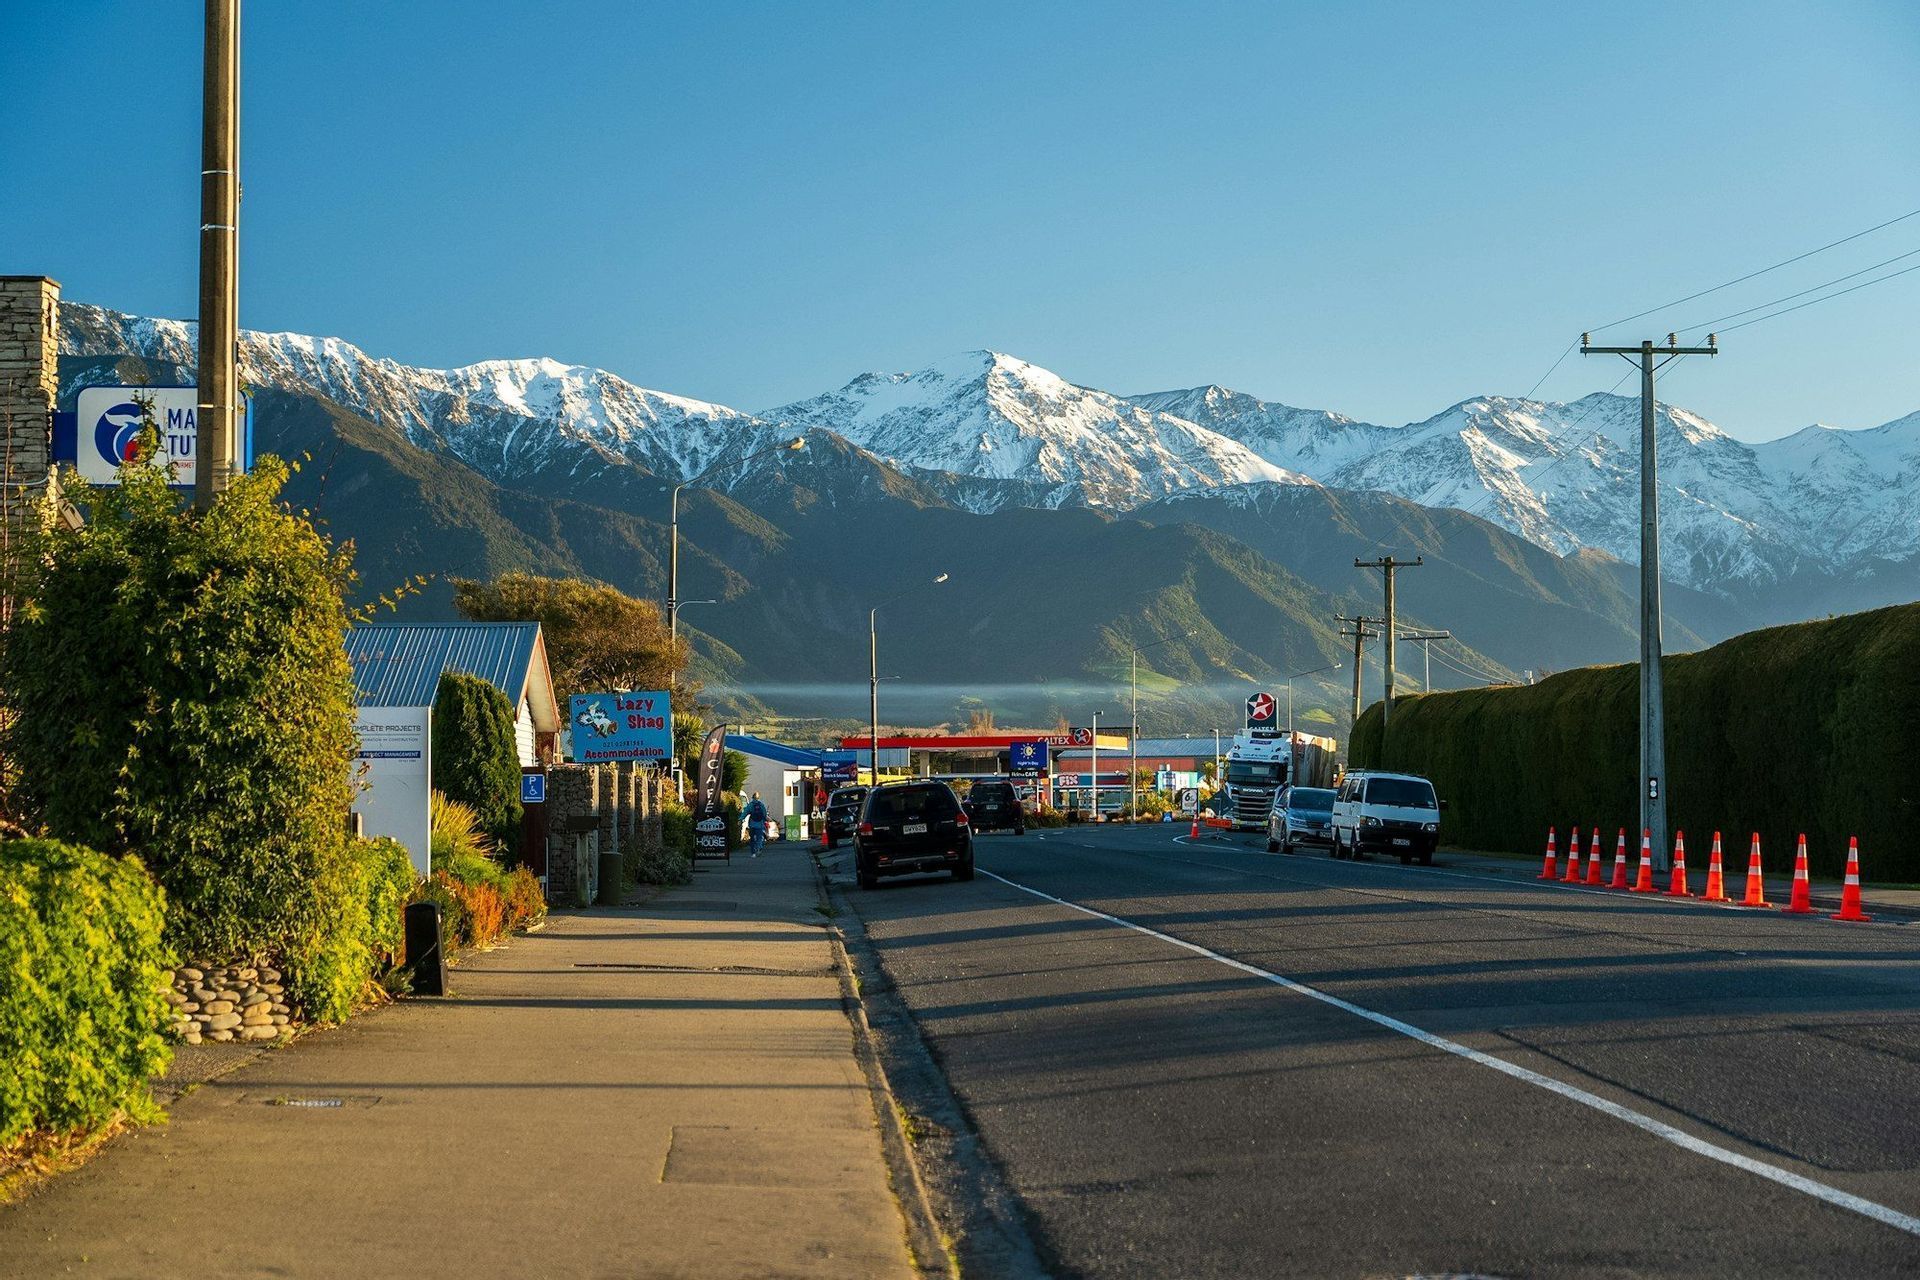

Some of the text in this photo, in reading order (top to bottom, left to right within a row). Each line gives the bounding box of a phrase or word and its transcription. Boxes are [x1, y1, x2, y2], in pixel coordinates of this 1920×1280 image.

[615, 699, 654, 712] Lazy
[627, 714, 664, 730] Shag
[584, 747, 664, 759] Accommodation
[529, 776, 537, 785] P
